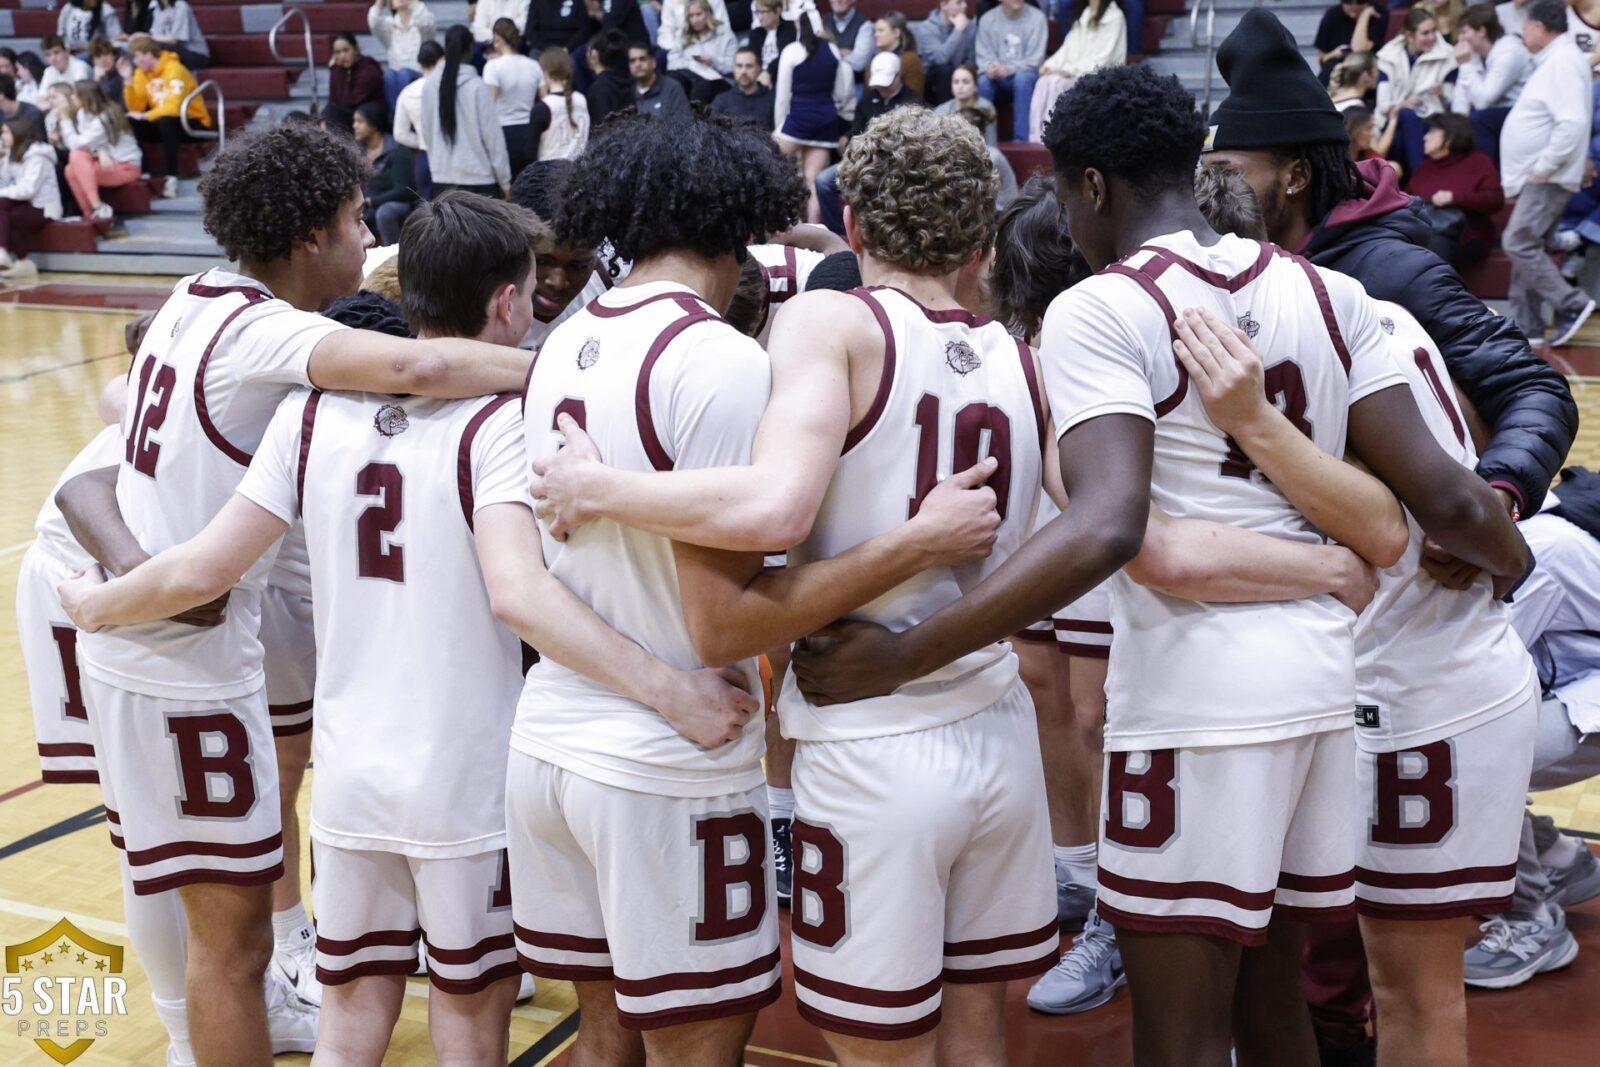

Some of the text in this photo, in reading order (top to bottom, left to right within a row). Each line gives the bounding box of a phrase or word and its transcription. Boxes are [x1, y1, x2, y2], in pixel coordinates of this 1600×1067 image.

[125, 353, 178, 480] 12
[906, 390, 1013, 526] 10
[355, 460, 406, 585] 2
[163, 709, 260, 822] B
[1102, 750, 1181, 854] B
[1366, 739, 1459, 849] B
[689, 807, 767, 946] B
